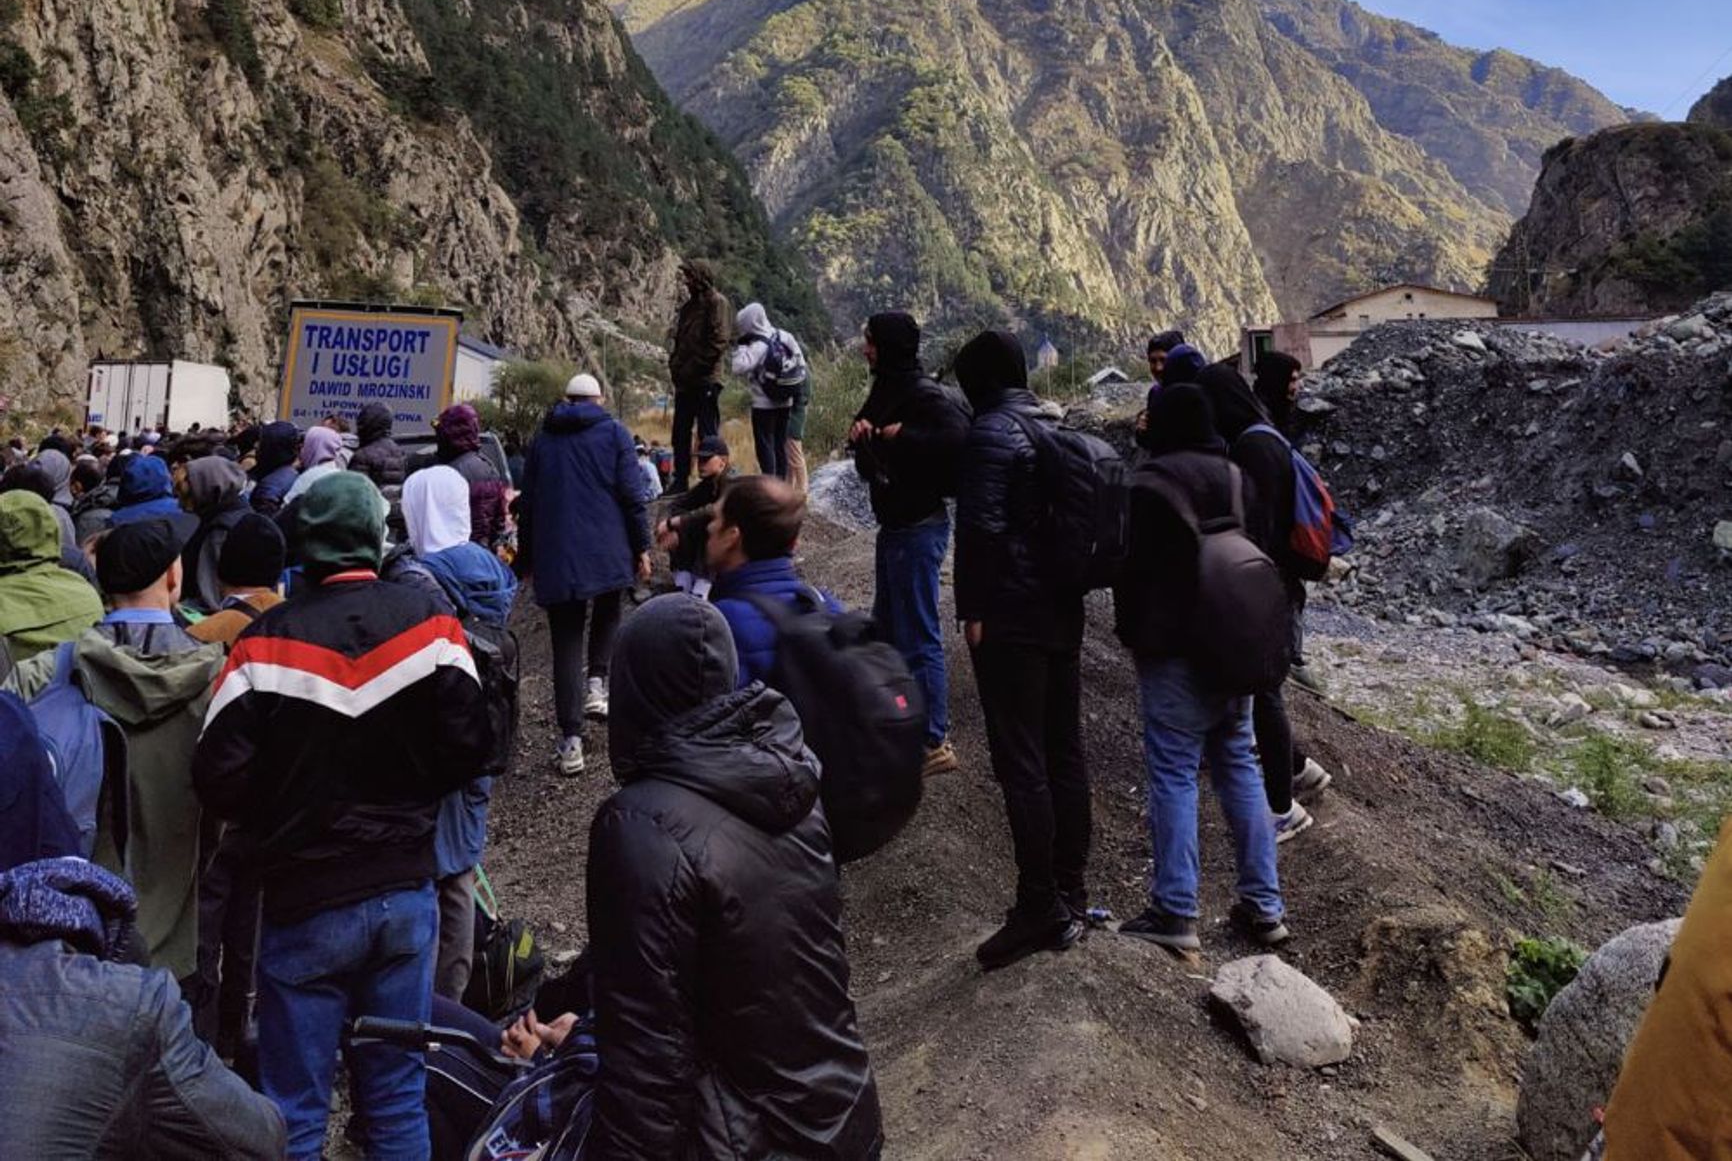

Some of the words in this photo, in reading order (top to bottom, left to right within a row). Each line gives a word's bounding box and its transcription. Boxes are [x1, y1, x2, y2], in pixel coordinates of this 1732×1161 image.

[305, 324, 430, 353] TRANSPORT
[312, 352, 320, 374] I
[333, 353, 410, 378] USŁUGI
[309, 380, 351, 396] DAWID
[357, 380, 430, 400] MROZIŃSKI
